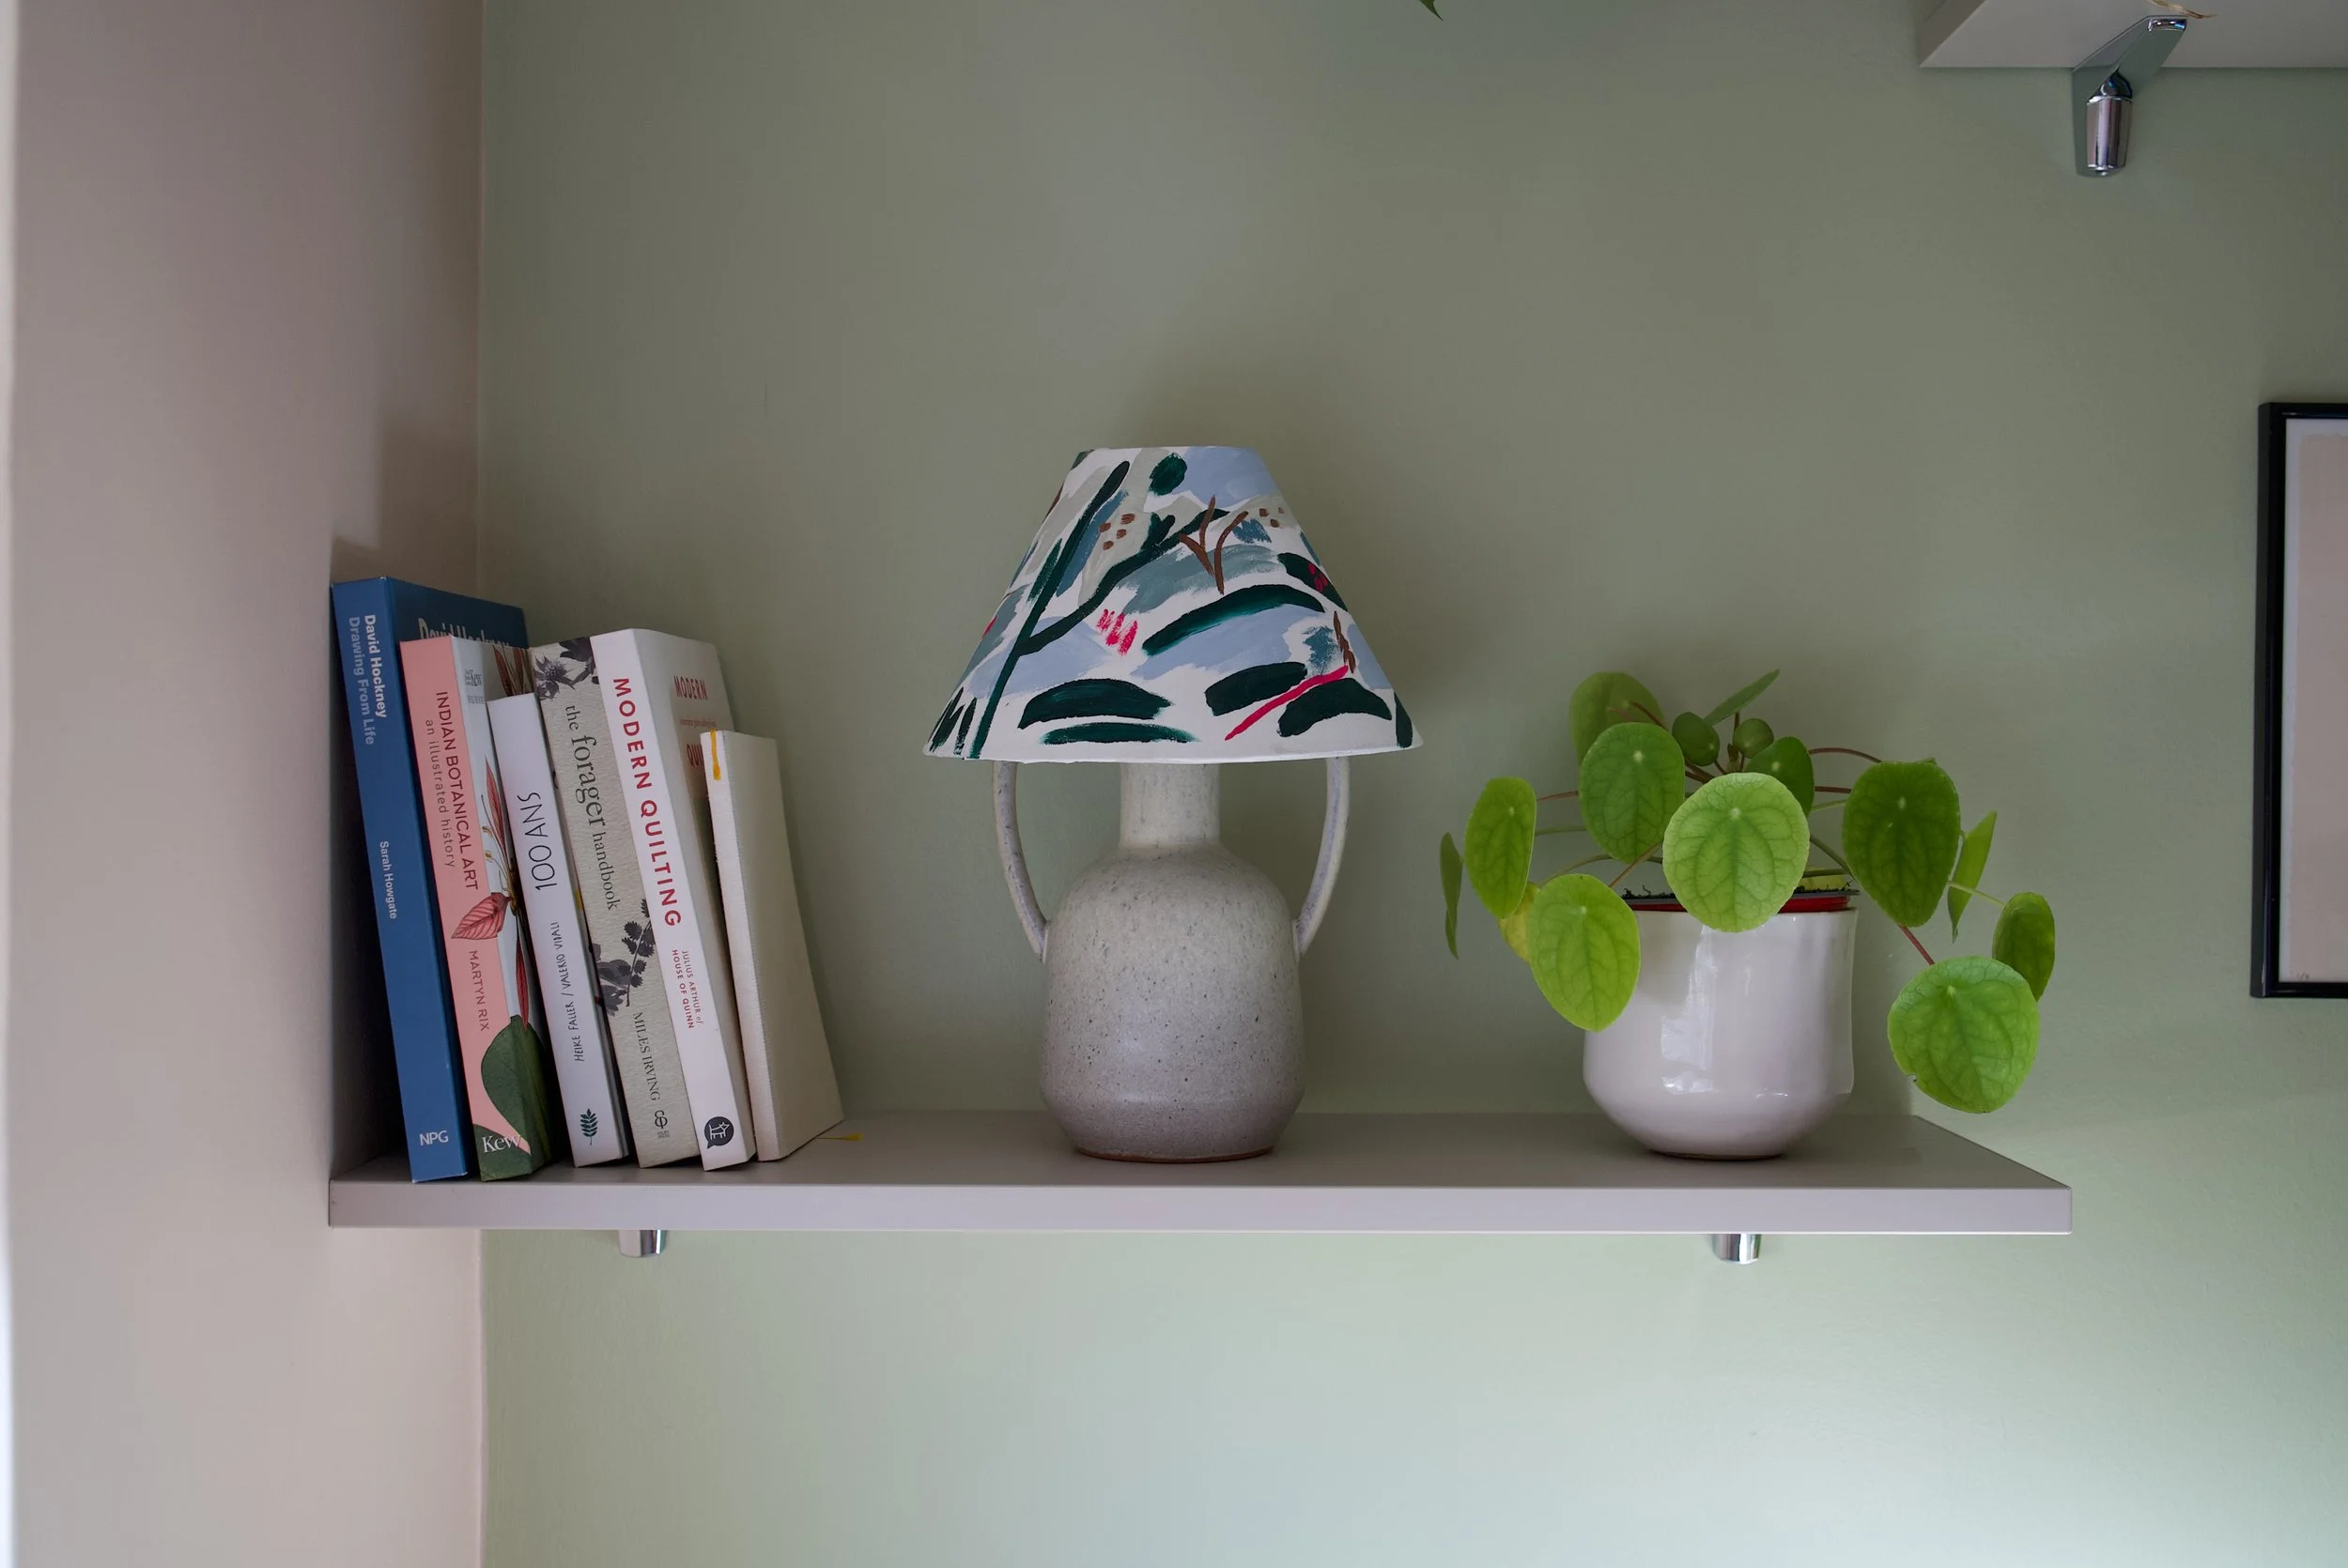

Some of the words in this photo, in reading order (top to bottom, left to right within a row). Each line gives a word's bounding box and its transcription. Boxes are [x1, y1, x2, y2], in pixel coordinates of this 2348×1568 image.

[348, 617, 364, 676] Drawing
[364, 614, 380, 654] David
[358, 679, 370, 715] From
[370, 657, 387, 718] Hockney
[673, 676, 708, 700] MODERN
[363, 717, 377, 745] Life
[425, 719, 435, 735] an
[436, 691, 456, 750] INDIAN
[565, 705, 580, 730] the
[428, 740, 449, 813] illustrated
[571, 734, 606, 826] forager
[445, 755, 471, 853] BOTANICAL
[517, 792, 548, 838] ANS
[612, 678, 653, 790] MODERN
[641, 800, 682, 926] QUILTING
[379, 840, 391, 871] Sarah
[441, 819, 456, 868] history
[461, 858, 478, 890] ART
[528, 845, 557, 890] 100
[592, 832, 621, 911] handbook
[384, 873, 396, 919] Howgate
[556, 954, 571, 990] VALERIO
[672, 949, 684, 979] HOUSE
[682, 950, 693, 978] JULIUS
[688, 981, 702, 1014] ARTHUR
[469, 950, 486, 1005] MARTYN
[478, 1008, 490, 1031] RIX
[679, 982, 687, 995] OF
[564, 1001, 579, 1031] FALLER
[633, 1011, 650, 1053] MILES
[682, 998, 695, 1029] QUINN
[571, 1035, 584, 1062] HEIKE
[641, 1055, 661, 1101] IRVING
[419, 1130, 449, 1146] NPG
[482, 1134, 521, 1153] Kew
